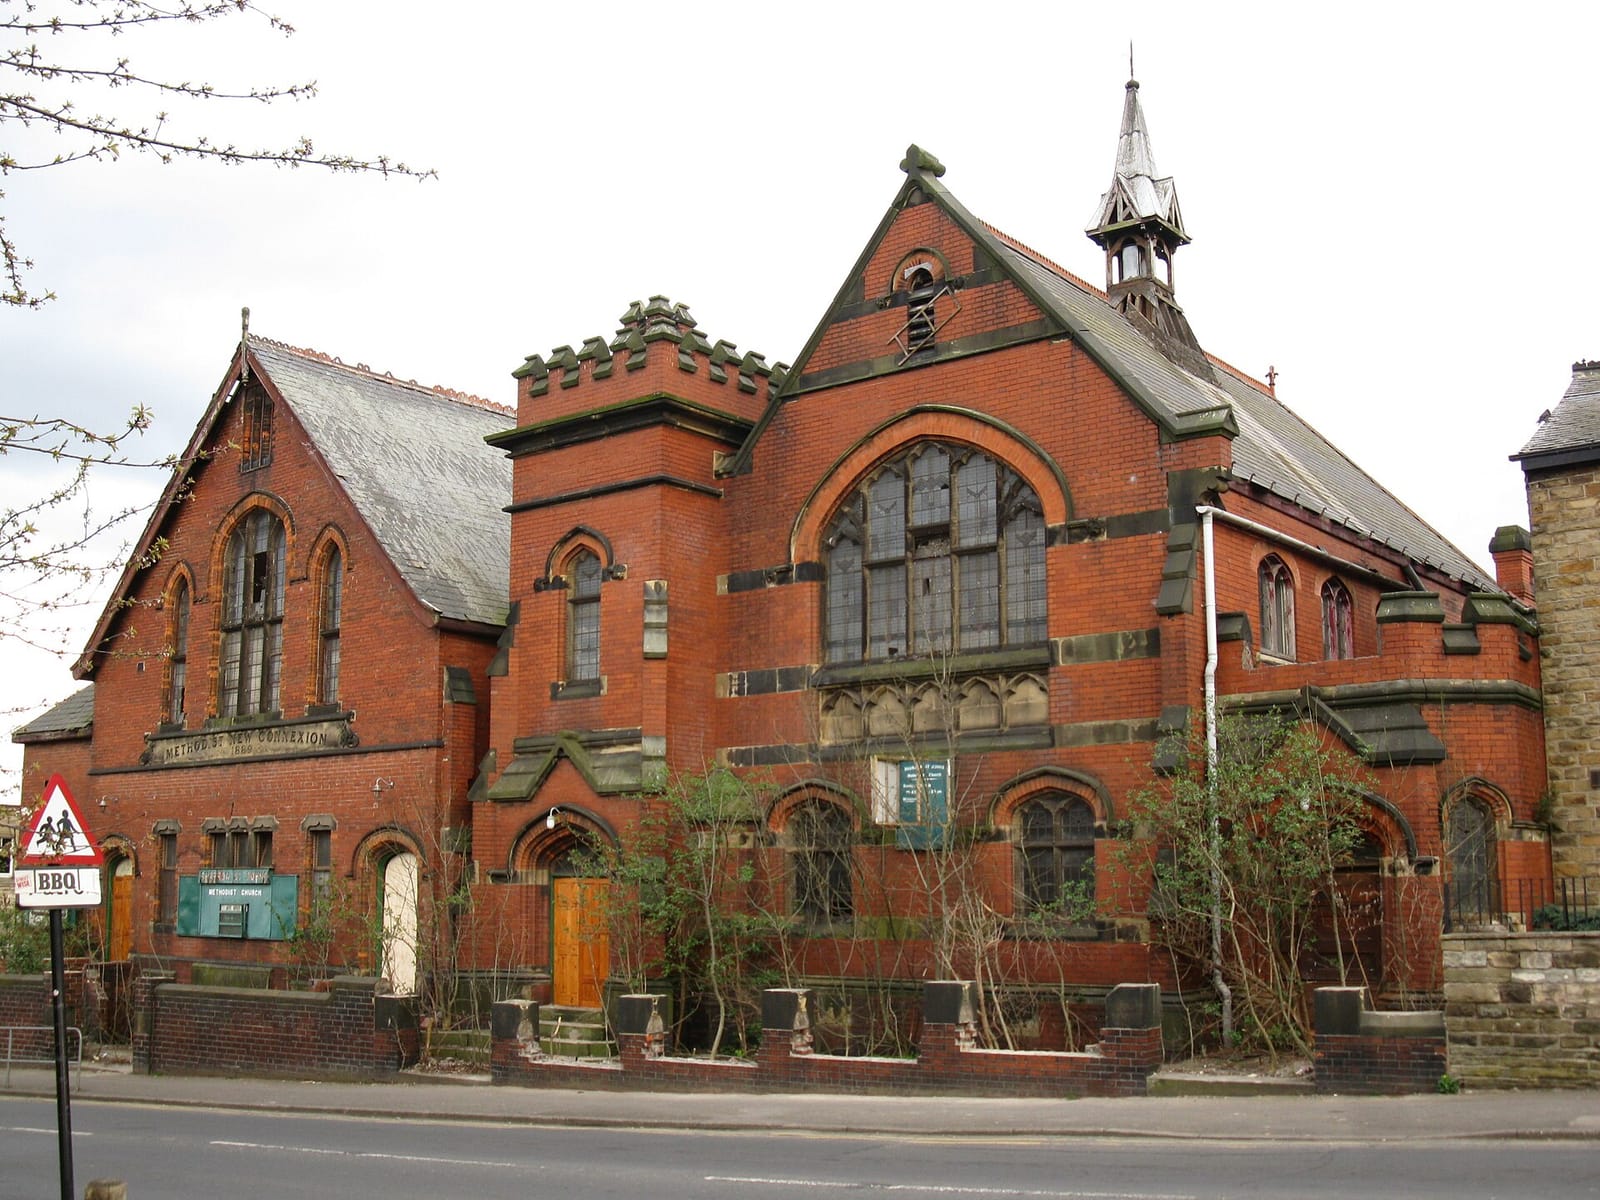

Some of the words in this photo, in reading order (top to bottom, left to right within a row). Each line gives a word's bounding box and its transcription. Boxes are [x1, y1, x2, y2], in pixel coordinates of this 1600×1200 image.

[165, 735, 224, 760] METHODST
[229, 731, 252, 746] NEW
[258, 728, 327, 746] CONNEXION
[38, 872, 76, 890] BBQ
[208, 888, 236, 896] METHODIST
